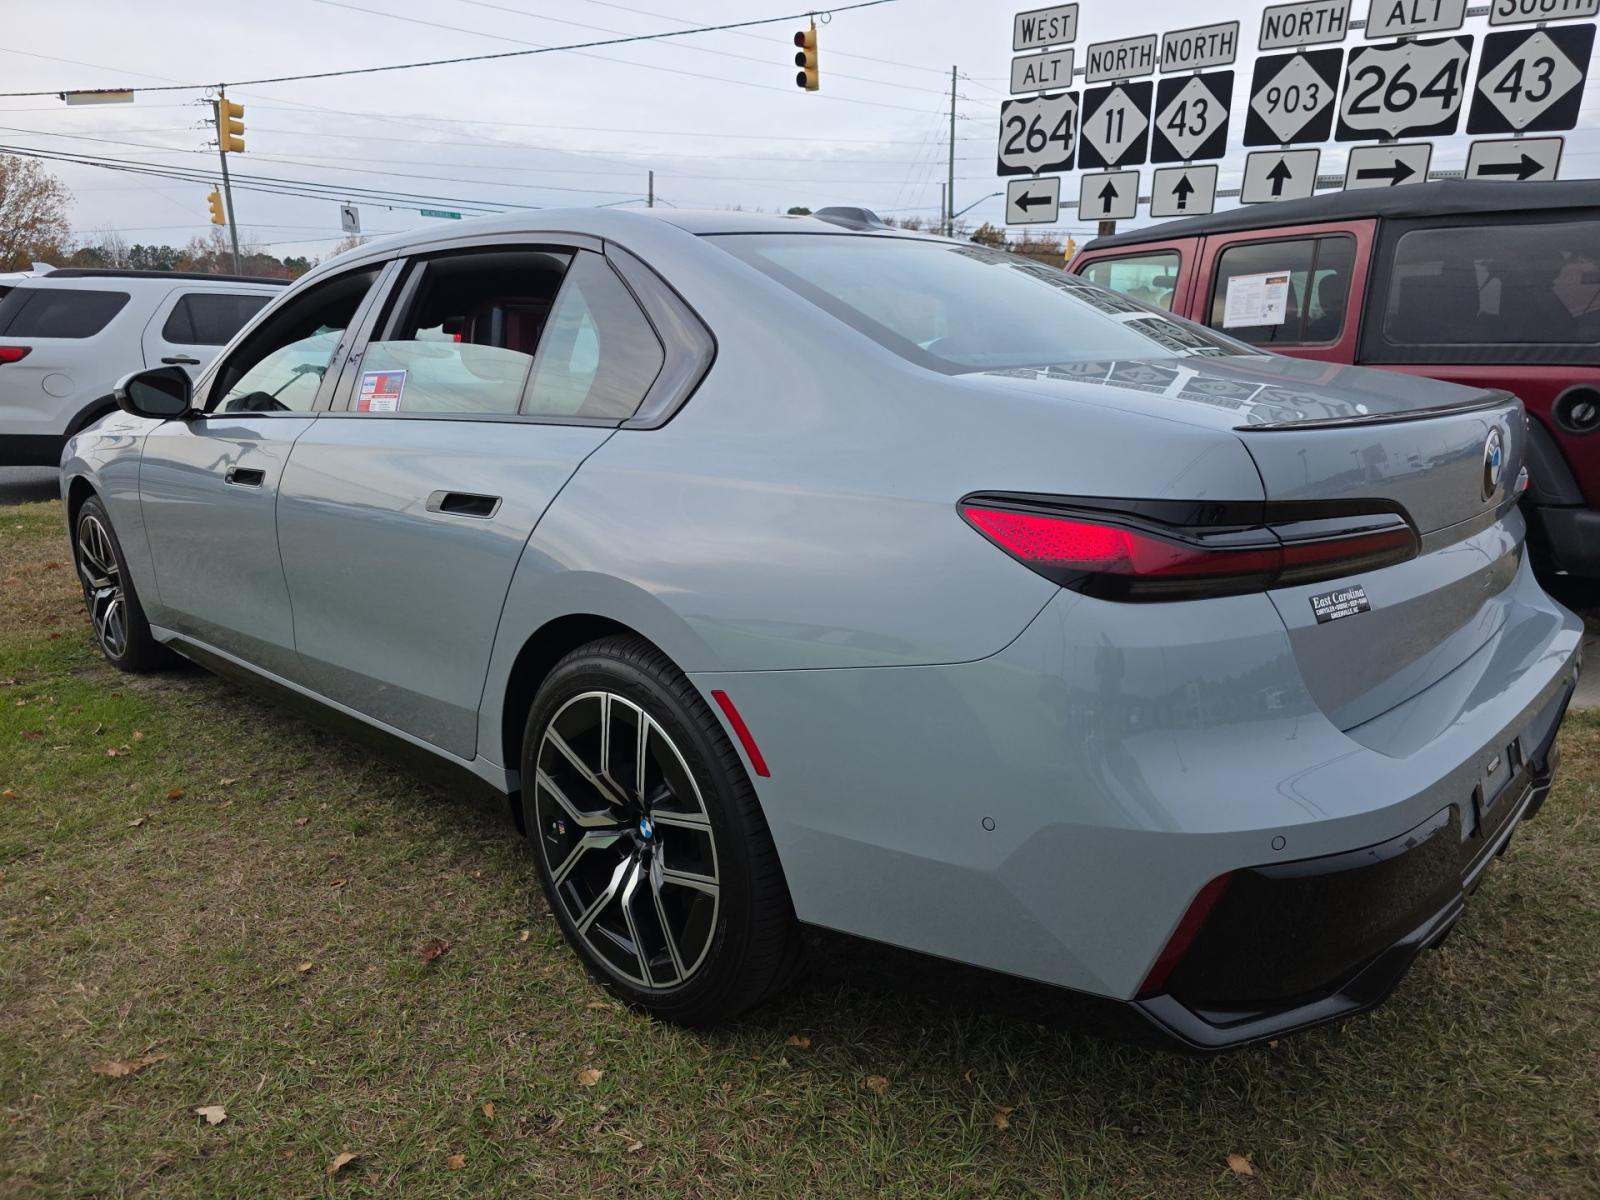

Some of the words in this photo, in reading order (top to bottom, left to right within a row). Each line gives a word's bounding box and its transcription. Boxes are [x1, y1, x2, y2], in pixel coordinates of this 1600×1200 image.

[1022, 15, 1071, 43] WEST
[1265, 6, 1345, 40] NORTH
[1090, 44, 1152, 74] NORTH
[1165, 31, 1233, 63] NORTH
[1023, 60, 1061, 85] ALT
[1347, 57, 1460, 115] 264
[1493, 56, 1556, 103] 43
[1266, 83, 1319, 114] 903
[1004, 109, 1073, 155] 264
[1105, 107, 1125, 144] 11
[1167, 98, 1208, 137] 43
[1312, 596, 1332, 609] East
[1332, 588, 1365, 603] Carolina
